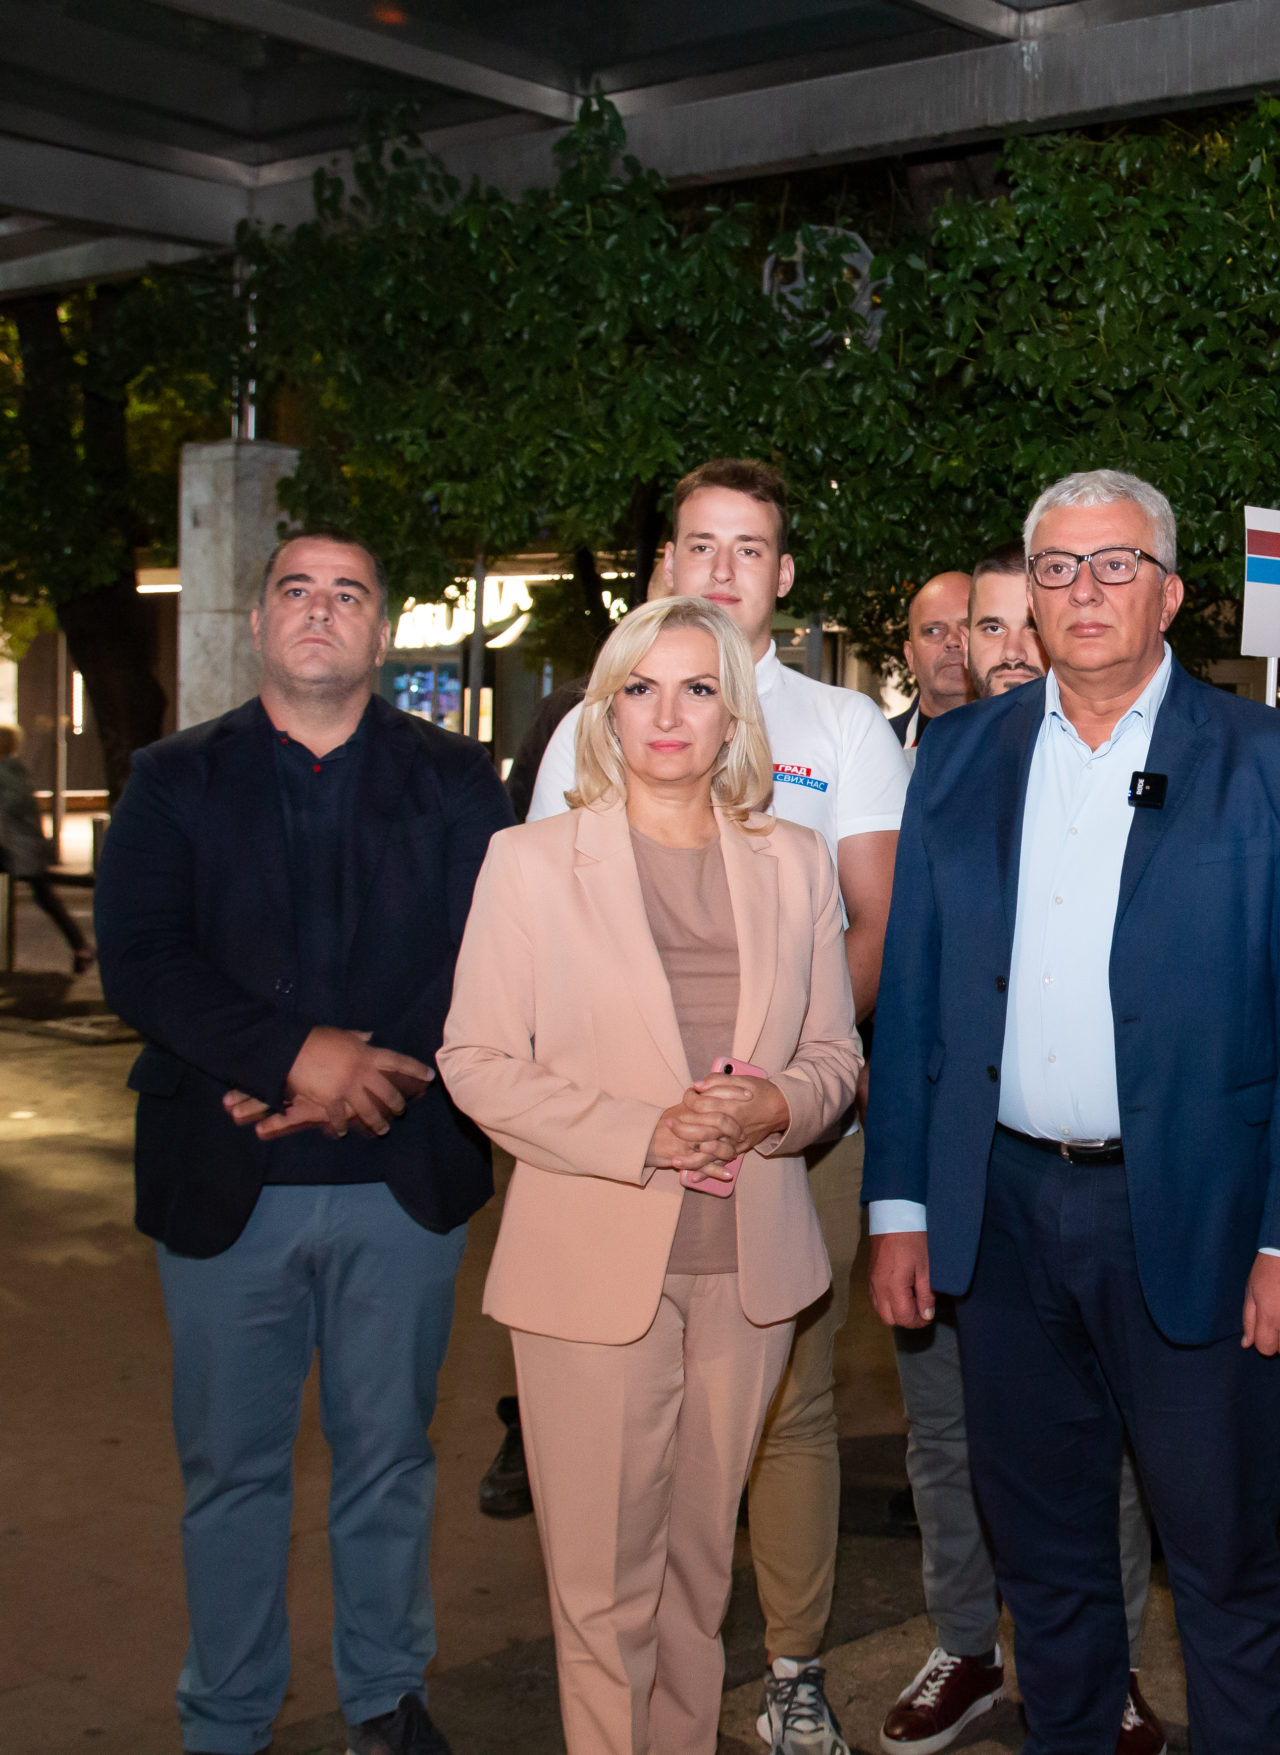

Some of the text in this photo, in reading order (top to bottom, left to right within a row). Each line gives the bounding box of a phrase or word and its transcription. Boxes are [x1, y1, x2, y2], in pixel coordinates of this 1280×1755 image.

[778, 764, 807, 777] ГРАД
[776, 773, 825, 791] СВИХ НАС
